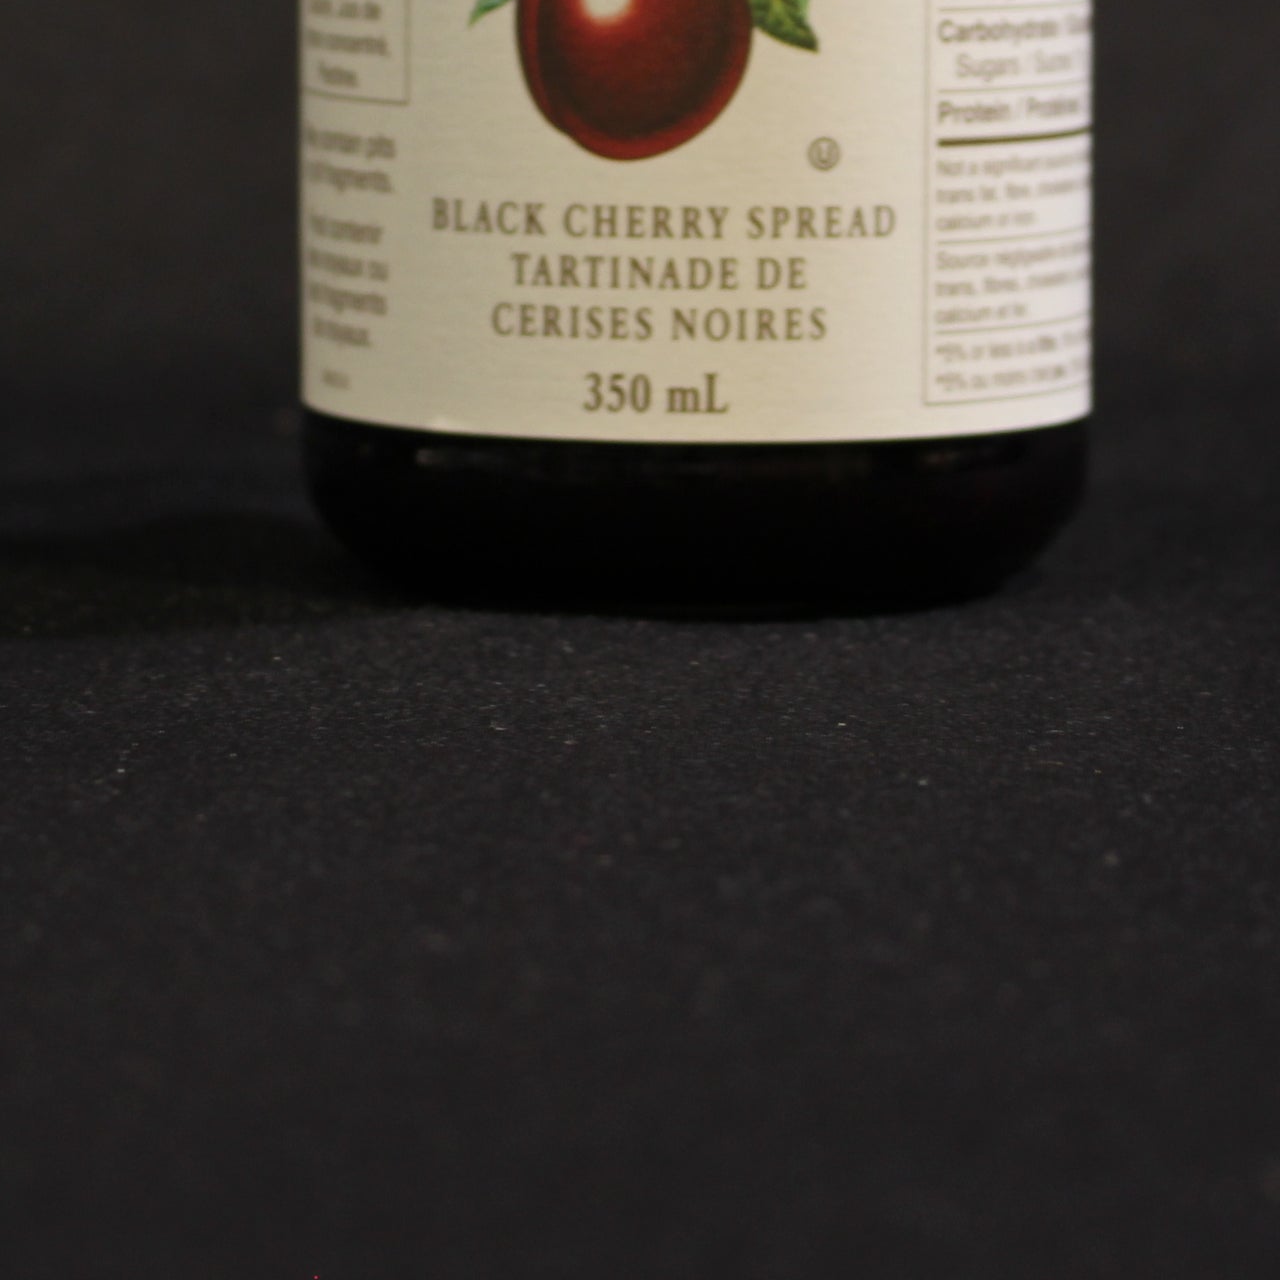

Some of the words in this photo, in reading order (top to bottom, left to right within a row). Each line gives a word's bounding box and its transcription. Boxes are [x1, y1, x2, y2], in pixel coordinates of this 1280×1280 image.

[432, 197, 547, 237] BLACK
[563, 204, 729, 239] CHERRY
[747, 205, 896, 239] SPREAD
[511, 253, 739, 290] TARTINADE
[756, 257, 807, 290] DE
[491, 303, 653, 341] CERISES
[670, 308, 827, 341] NOIRES
[583, 372, 651, 413] 350
[667, 372, 728, 413] mL
